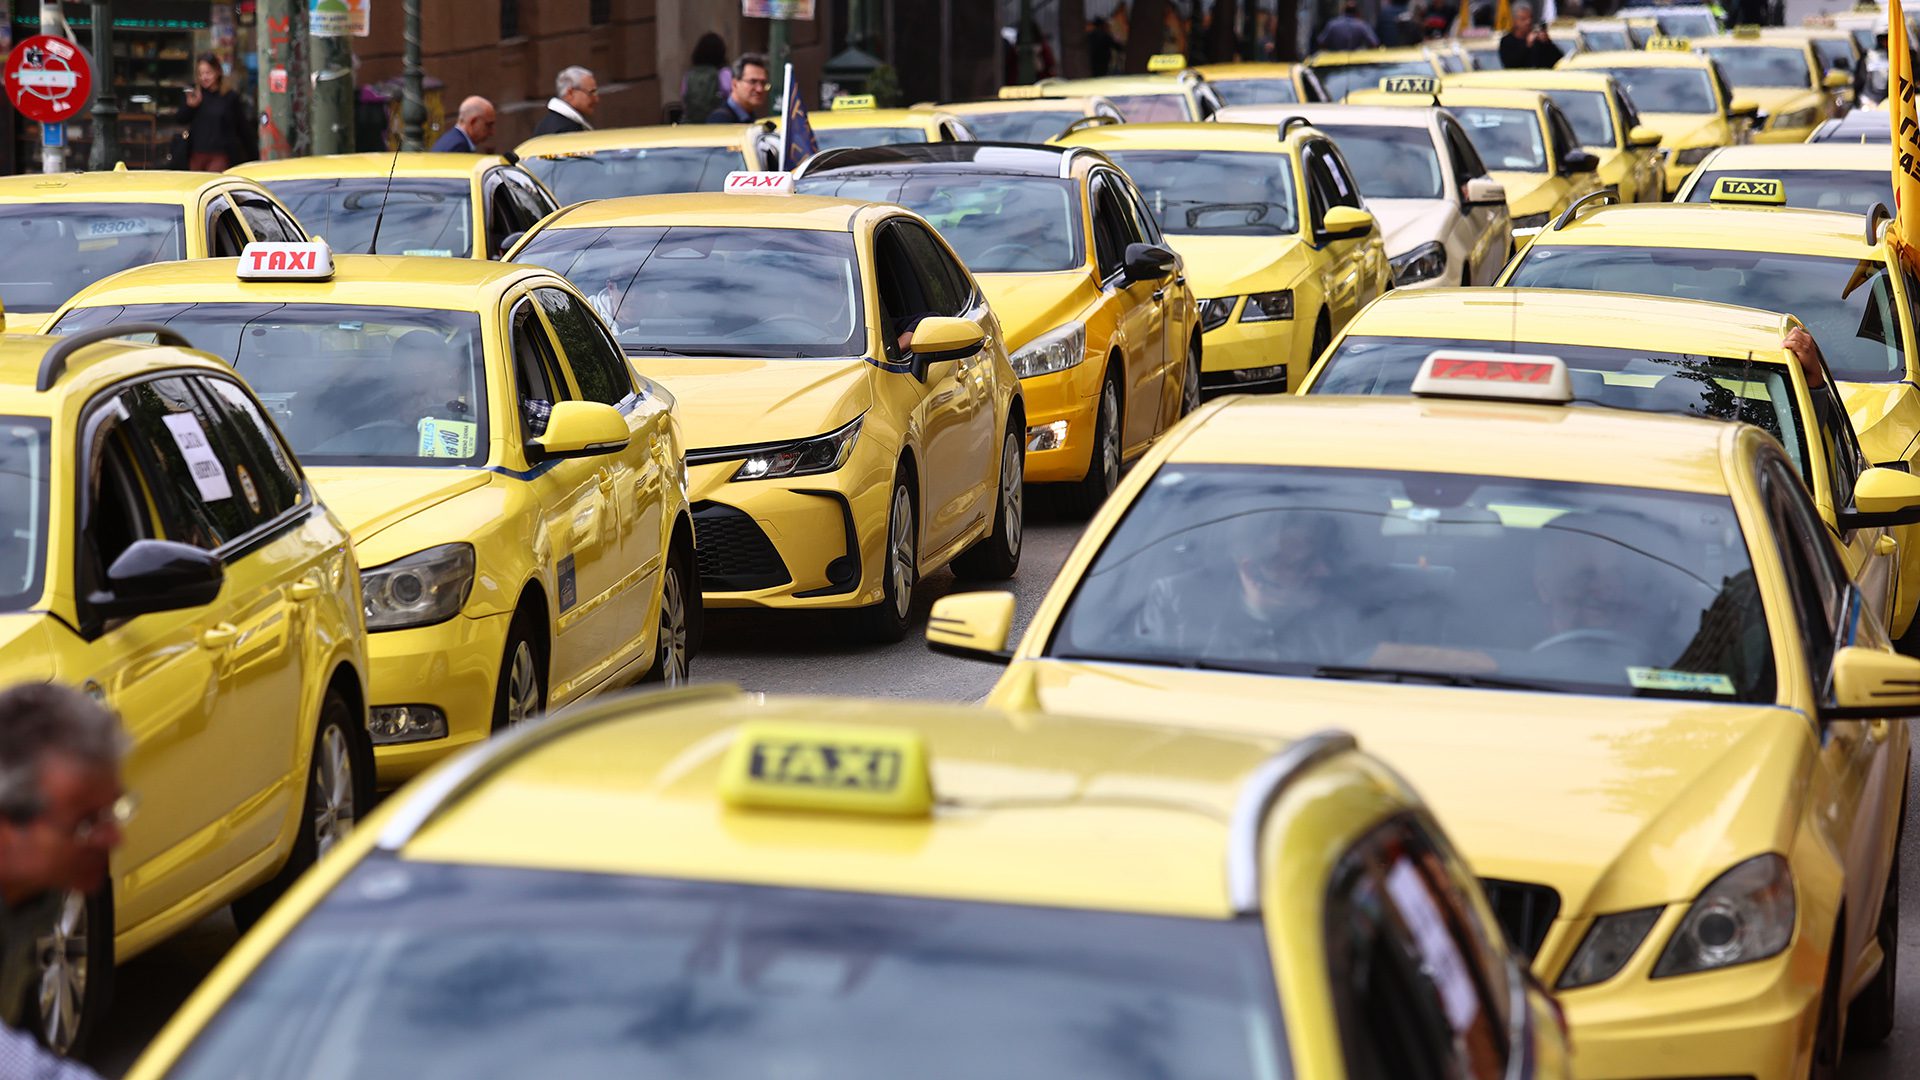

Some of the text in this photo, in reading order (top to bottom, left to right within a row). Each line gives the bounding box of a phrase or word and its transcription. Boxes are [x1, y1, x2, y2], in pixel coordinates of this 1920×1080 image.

[1387, 79, 1432, 92] TAXI
[730, 175, 785, 187] TAXI
[1726, 181, 1775, 195] TAXI
[91, 220, 135, 234] 18300
[250, 251, 316, 270] TAXI
[1430, 358, 1553, 384] TAXI
[752, 744, 898, 792] TAXI
